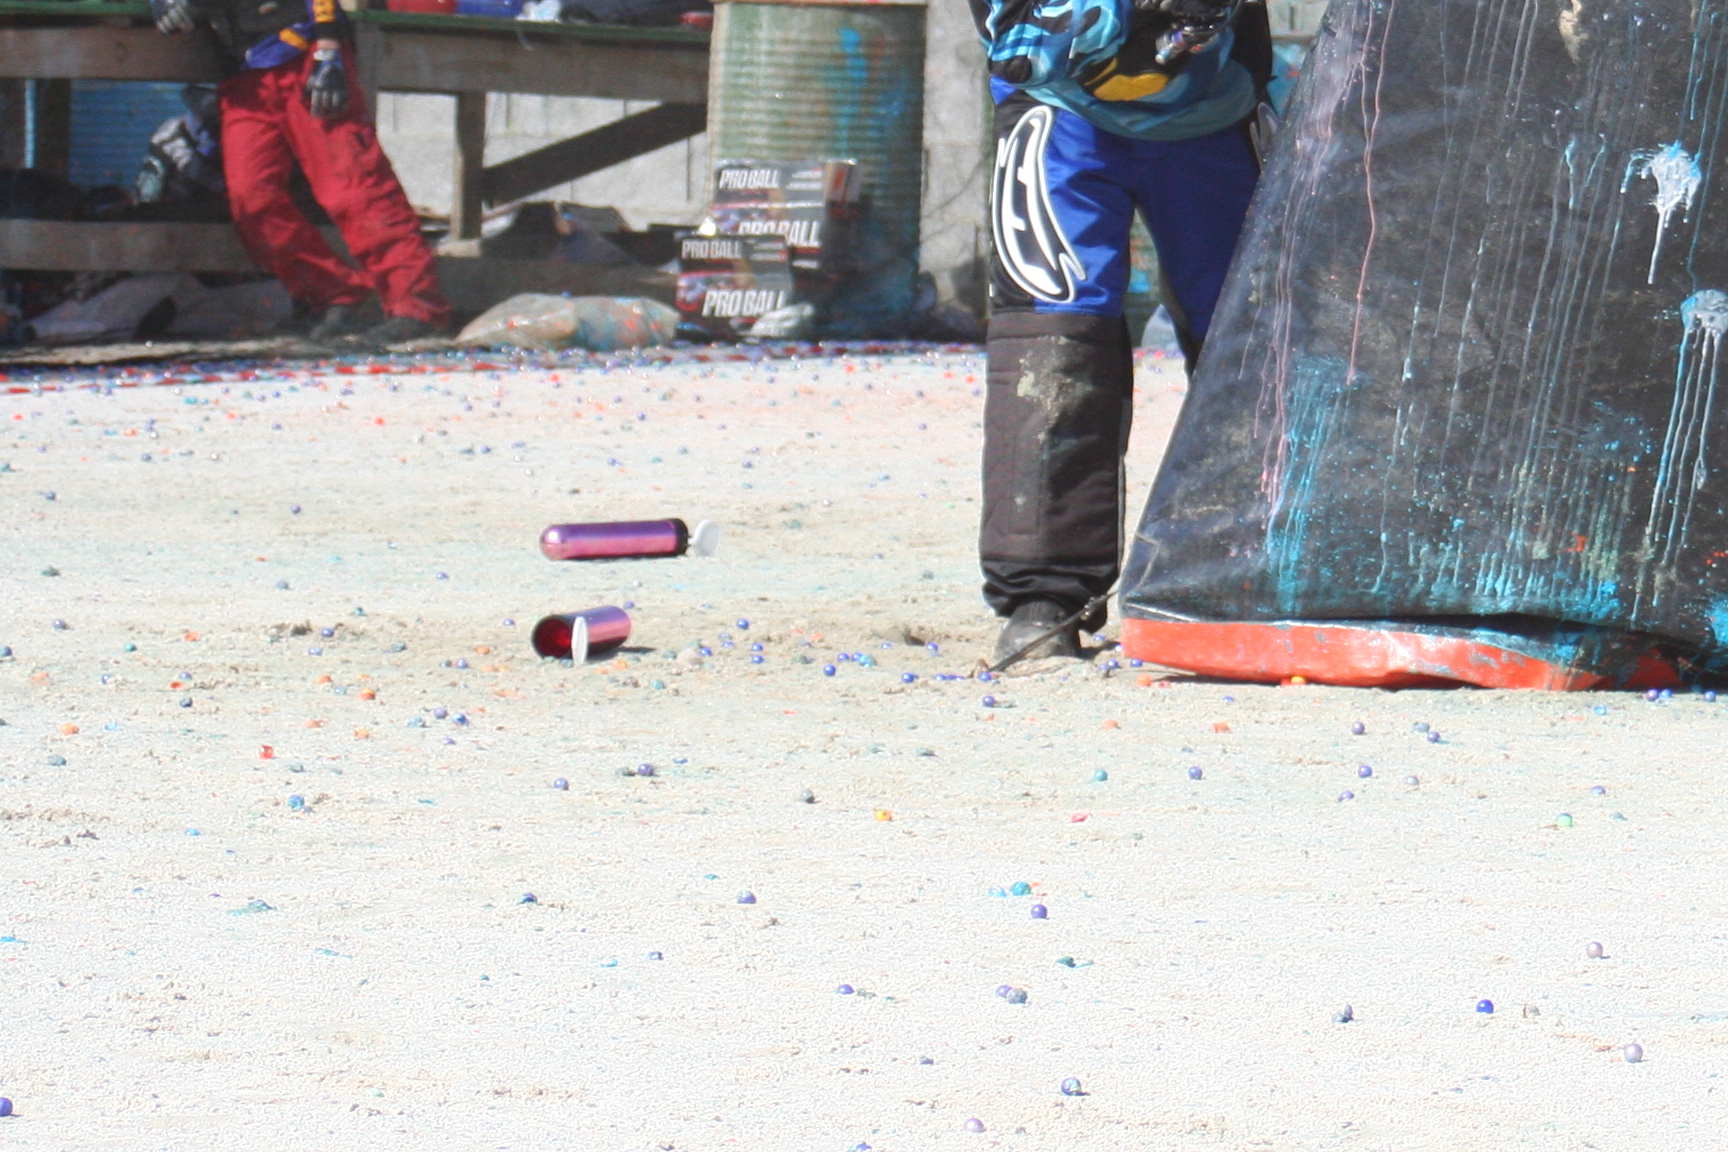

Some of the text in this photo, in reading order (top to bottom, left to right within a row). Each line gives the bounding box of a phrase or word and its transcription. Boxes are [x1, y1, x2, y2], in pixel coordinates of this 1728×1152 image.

[719, 169, 748, 189] PRO
[747, 169, 780, 188] BALL
[681, 239, 710, 259] PRO
[709, 239, 743, 259] BALL
[701, 289, 743, 318] PRO
